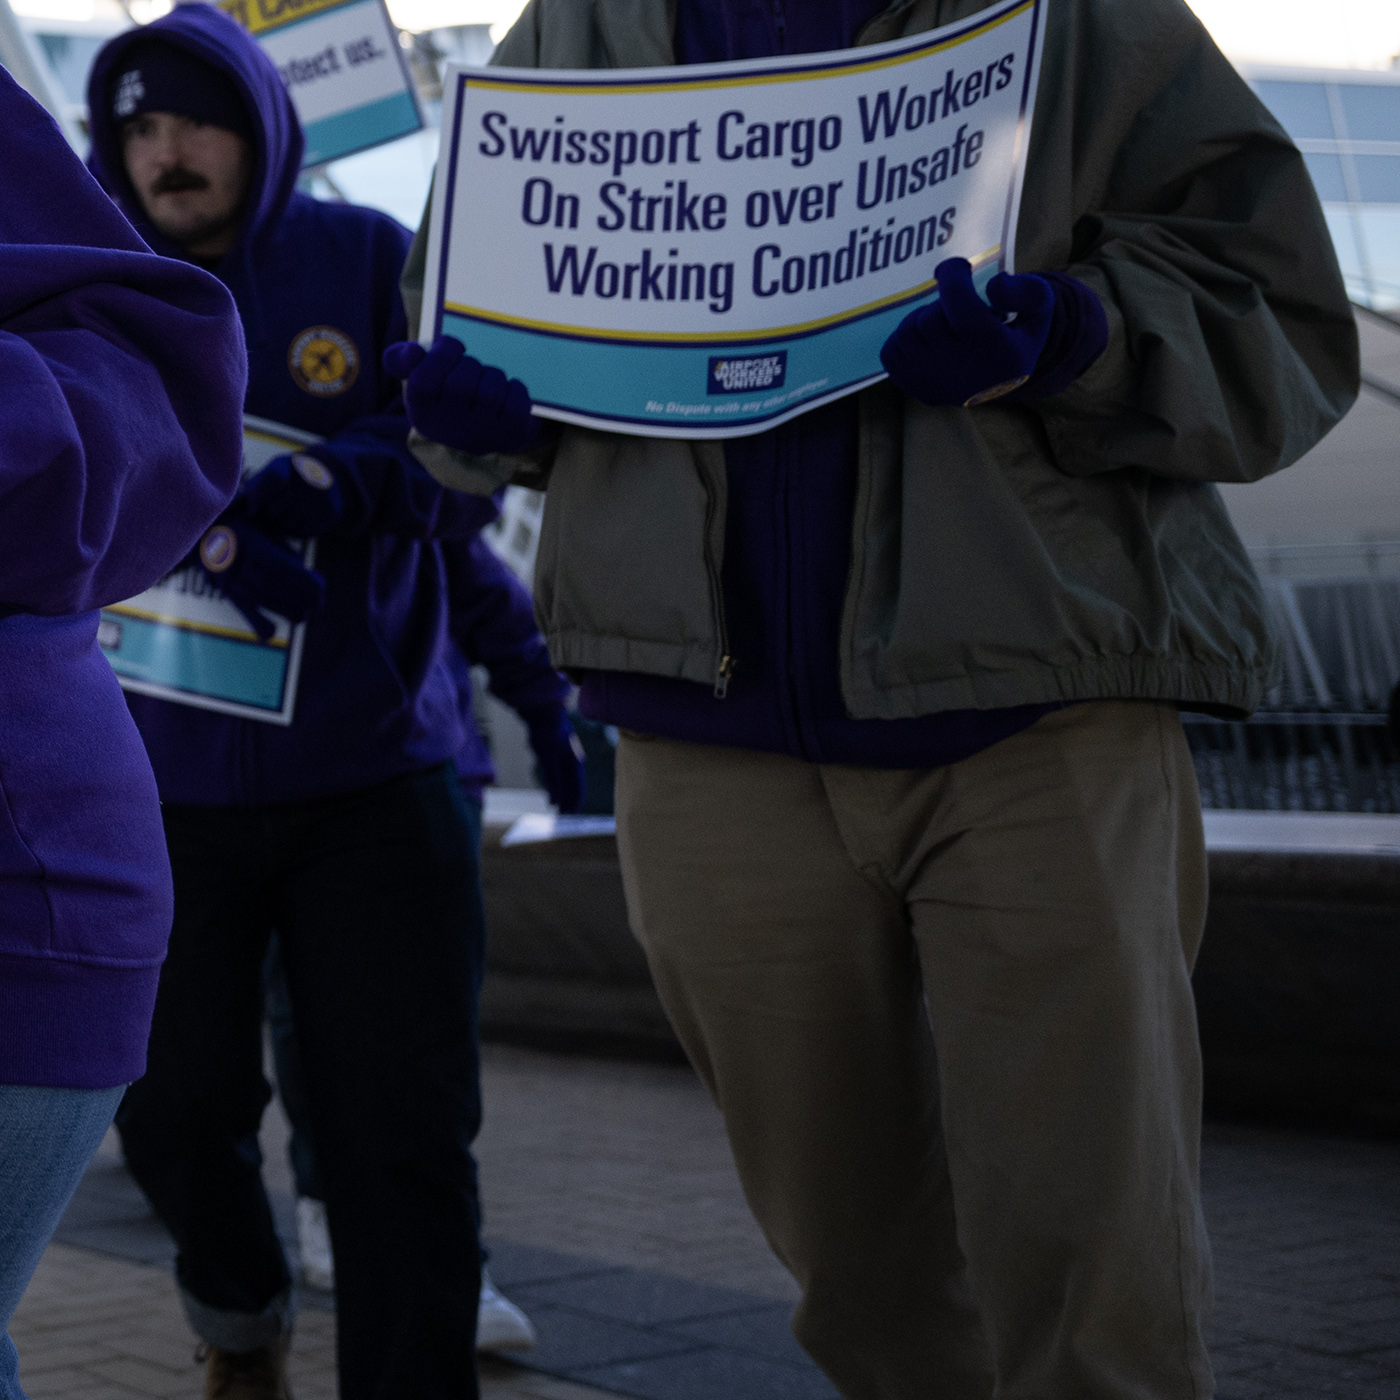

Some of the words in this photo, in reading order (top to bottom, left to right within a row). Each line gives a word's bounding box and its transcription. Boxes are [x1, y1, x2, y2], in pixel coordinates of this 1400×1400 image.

[278, 40, 341, 88] otect
[478, 110, 703, 177] Swissport
[715, 110, 843, 168] Cargo
[857, 51, 1015, 144] Workers
[520, 177, 581, 229] On
[597, 181, 728, 233] Strike
[745, 180, 844, 230] over
[856, 123, 984, 211] Unsafe
[543, 243, 735, 314] Working
[751, 205, 958, 299] Conditions
[719, 356, 780, 372] AIRPORT
[723, 375, 774, 390] UNITED
[645, 400, 663, 413] No
[666, 401, 711, 416] Dispute
[714, 401, 740, 414] with
